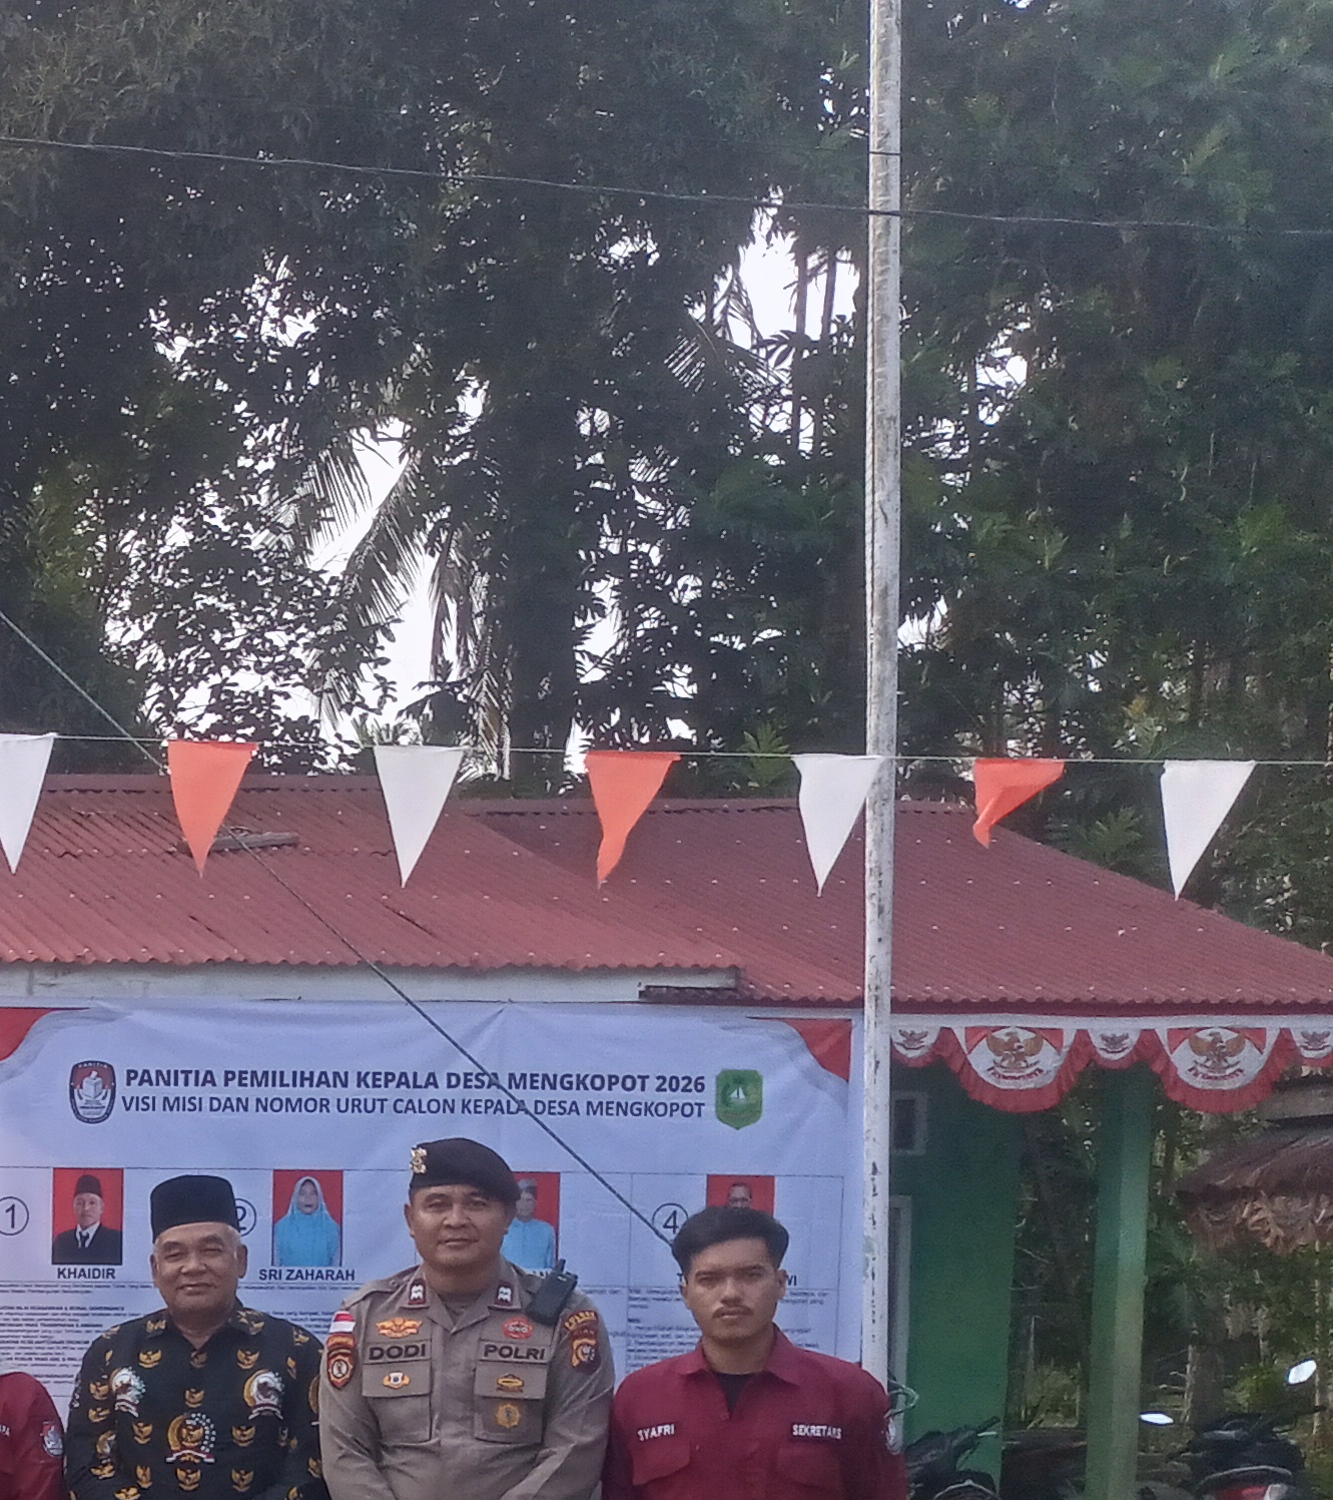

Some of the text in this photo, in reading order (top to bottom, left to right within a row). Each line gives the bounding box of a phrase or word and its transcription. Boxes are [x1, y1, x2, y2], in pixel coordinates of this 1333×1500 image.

[125, 1069, 706, 1093] PANITIA PEMILIHAN KEPALA DESA MENGKOPOT 2026
[122, 1095, 156, 1112] VISI
[162, 1096, 202, 1112] MISI
[209, 1096, 249, 1113] DAN
[255, 1097, 330, 1114] NOMOR
[336, 1098, 387, 1114] URUT
[393, 1098, 455, 1114] CALON
[461, 1098, 528, 1115] KEPALA
[534, 1100, 580, 1116] DESA
[586, 1100, 705, 1118] MENGKOPOT
[662, 1209, 679, 1234] 4
[57, 1267, 116, 1279] KHAIDIR
[259, 1269, 355, 1281] SRI ZAHARAH
[369, 1344, 426, 1360] DODI
[484, 1344, 545, 1360] POLRI
[637, 1423, 675, 1442] SYAFRI
